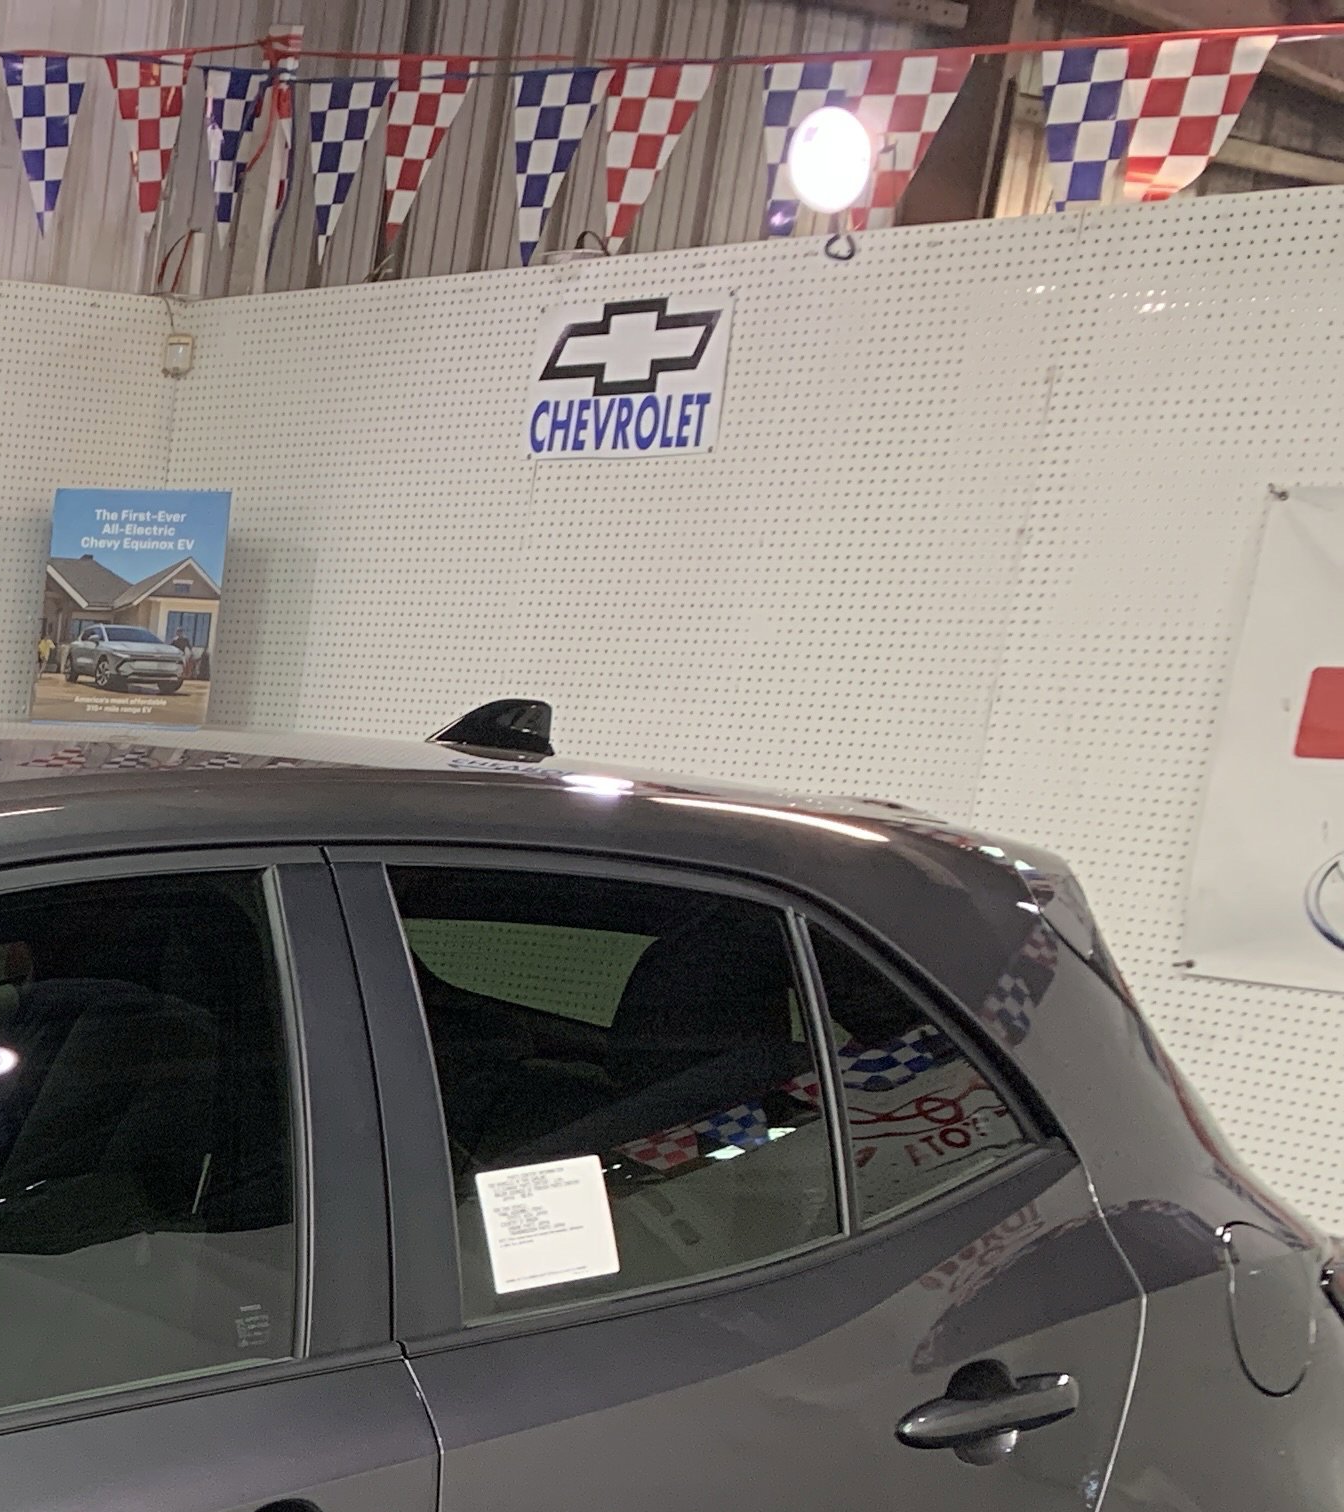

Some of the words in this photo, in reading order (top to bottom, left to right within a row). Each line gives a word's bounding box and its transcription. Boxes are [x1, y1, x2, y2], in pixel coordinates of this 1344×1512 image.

[530, 392, 712, 454] CHEVROLET
[95, 508, 119, 521] The
[121, 508, 187, 523] First-Ever
[102, 523, 176, 537] All-Electric
[81, 536, 121, 551] Chevy
[123, 537, 174, 551] Equinox
[177, 538, 195, 550] EV
